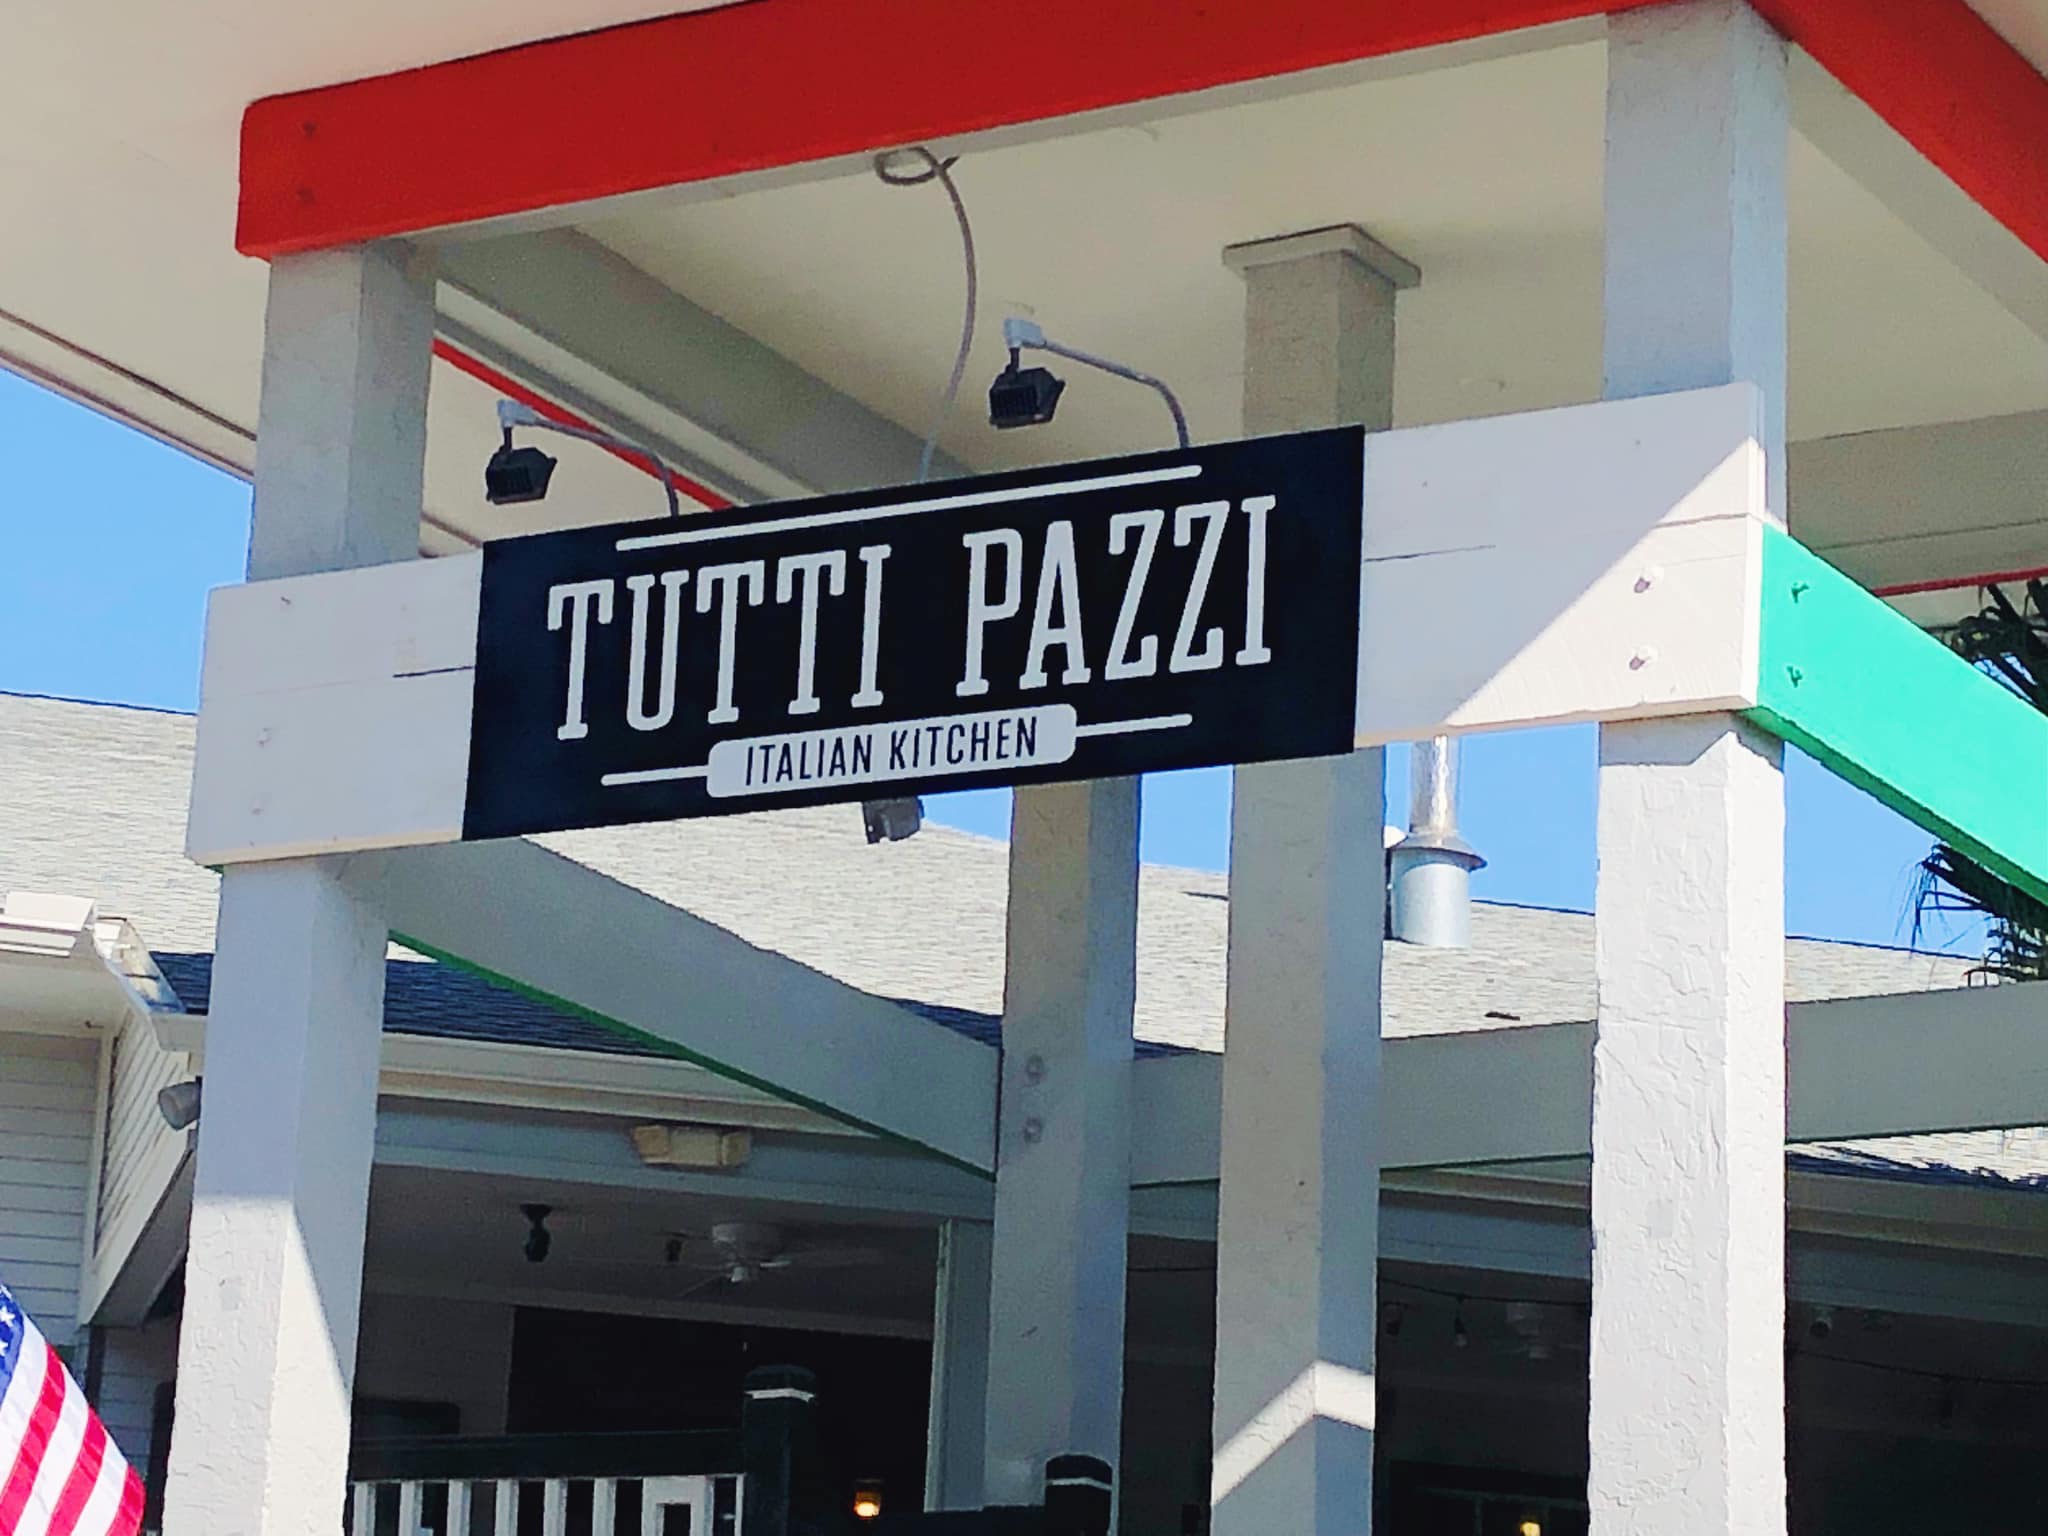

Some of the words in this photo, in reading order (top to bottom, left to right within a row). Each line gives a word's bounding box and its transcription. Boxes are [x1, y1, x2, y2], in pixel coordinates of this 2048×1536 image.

[547, 544, 892, 741] TUTTI
[956, 494, 1276, 697] PAZZI
[745, 733, 873, 787] ITALIAN
[889, 715, 1038, 771] KITCHEN
